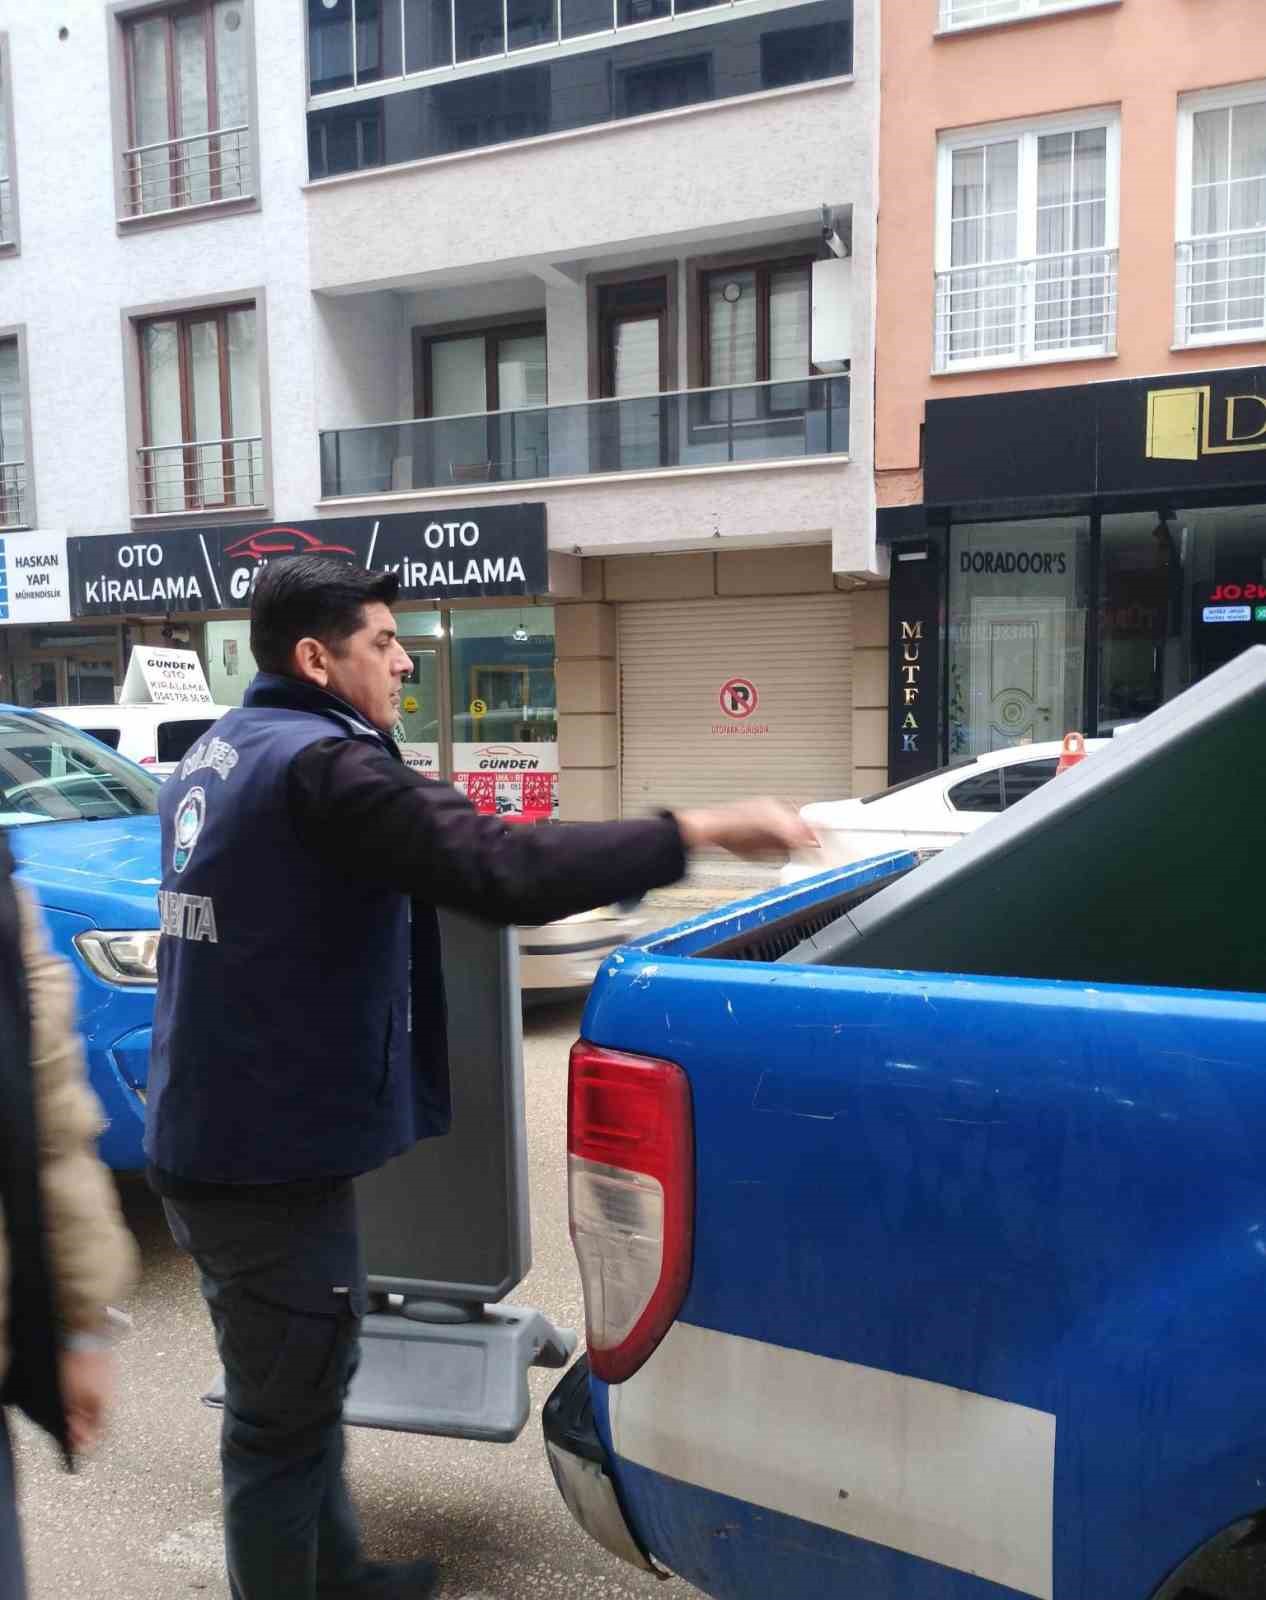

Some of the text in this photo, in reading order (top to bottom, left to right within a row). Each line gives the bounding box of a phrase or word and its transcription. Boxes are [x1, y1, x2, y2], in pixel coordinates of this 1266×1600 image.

[422, 521, 480, 549] OTO
[15, 554, 59, 568] HASKAN
[118, 543, 164, 568] OTO
[960, 551, 1067, 574] DORADOOR'S
[26, 574, 50, 585] YAPI
[85, 574, 202, 603] KİRALAMA
[901, 621, 923, 751] MUTFAK
